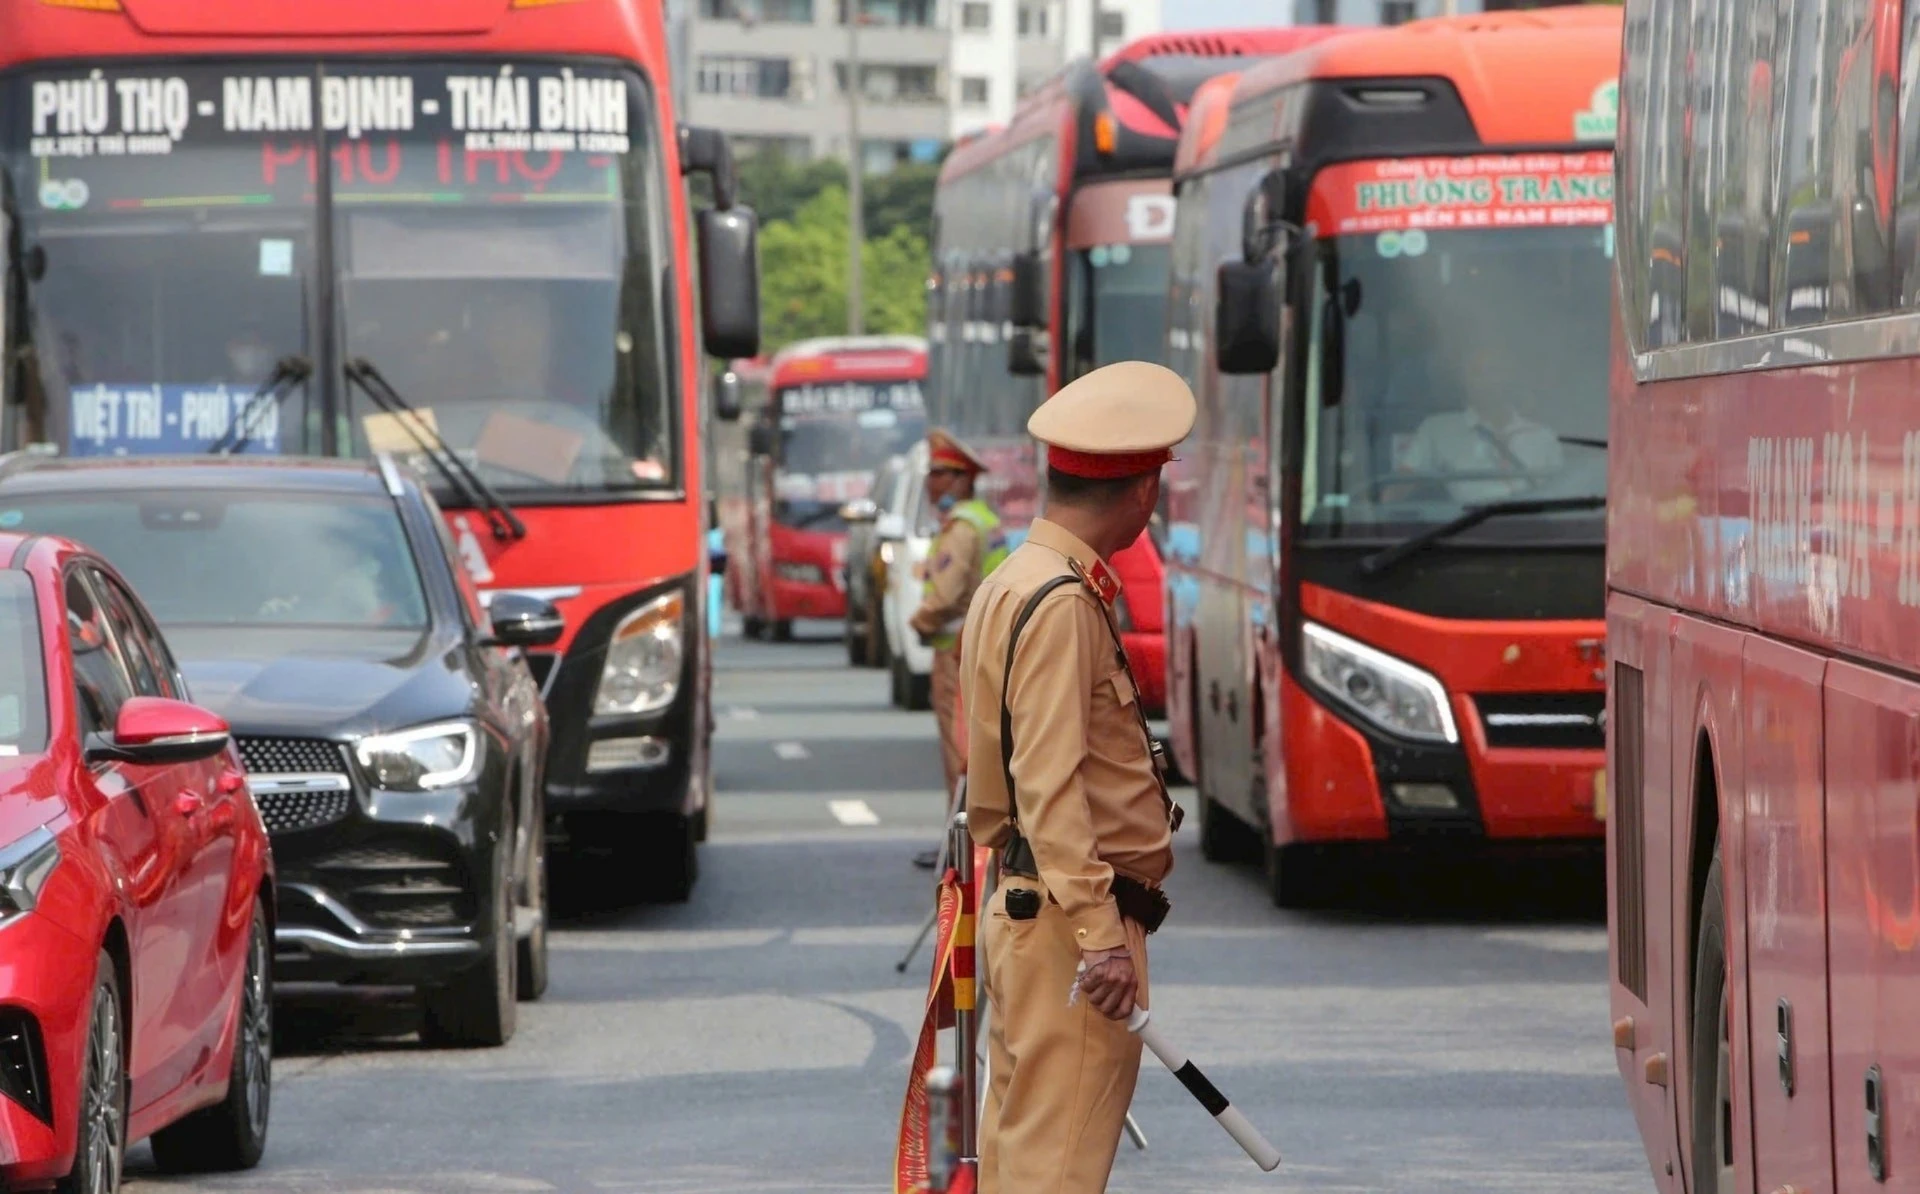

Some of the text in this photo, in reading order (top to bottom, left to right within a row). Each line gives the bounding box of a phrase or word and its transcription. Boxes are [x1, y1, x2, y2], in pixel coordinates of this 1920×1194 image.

[33, 64, 628, 141] PHÚ THỌ - NAM ĐỊNH - THÁI BÌNH
[1500, 173, 1614, 206] TRANG
[72, 382, 121, 446] VIỆT
[125, 382, 161, 439] TRÌ
[181, 382, 229, 440] PHÚ
